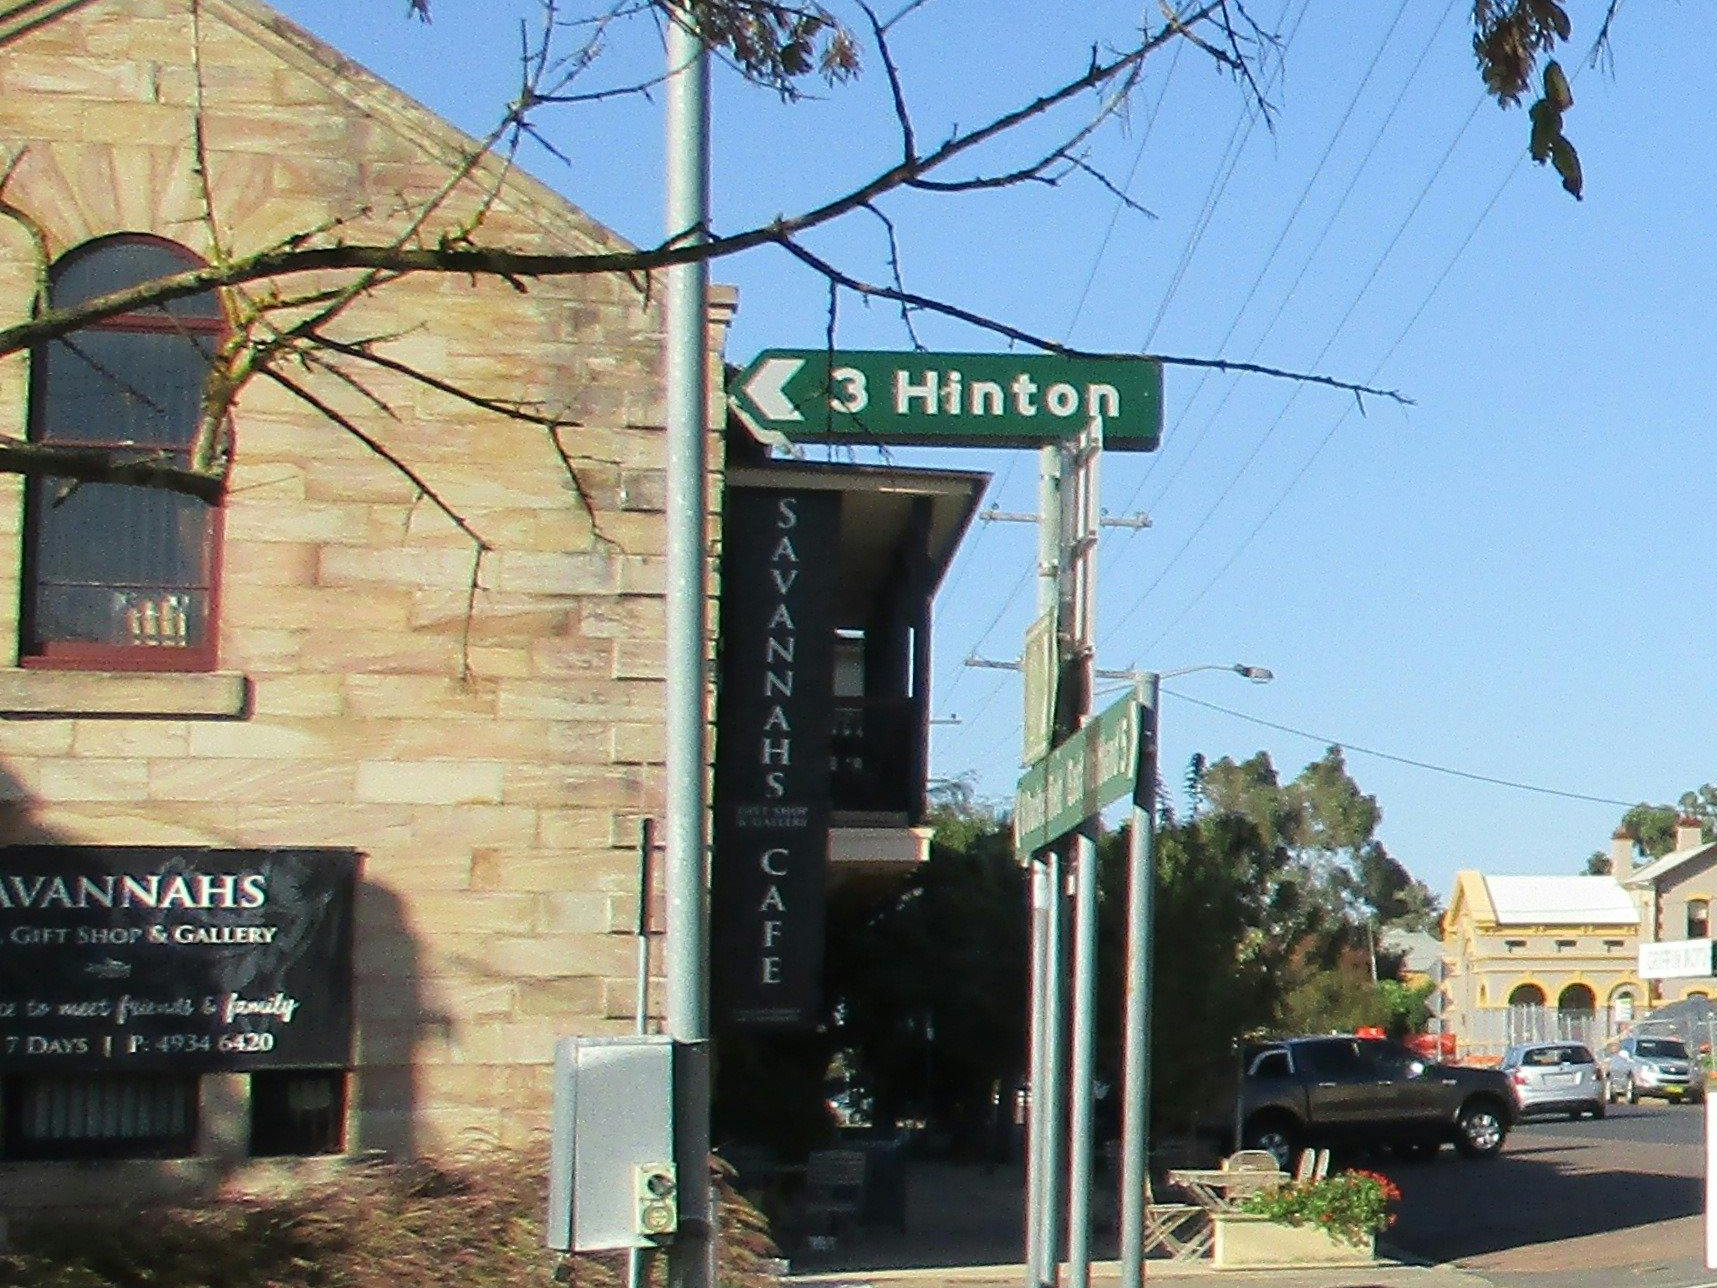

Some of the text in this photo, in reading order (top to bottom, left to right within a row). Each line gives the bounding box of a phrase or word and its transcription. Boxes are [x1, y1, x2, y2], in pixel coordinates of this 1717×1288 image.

[831, 367, 1121, 418] 3 Hinton
[764, 498, 800, 799] SAVANNAHS
[10, 924, 278, 945] GIFT SHOP & GALLERY
[760, 848, 789, 984] CAFE
[222, 992, 300, 1024] family
[5, 1035, 20, 1054] 7
[26, 1035, 90, 1055] DAYS
[217, 1031, 276, 1053] 6420
